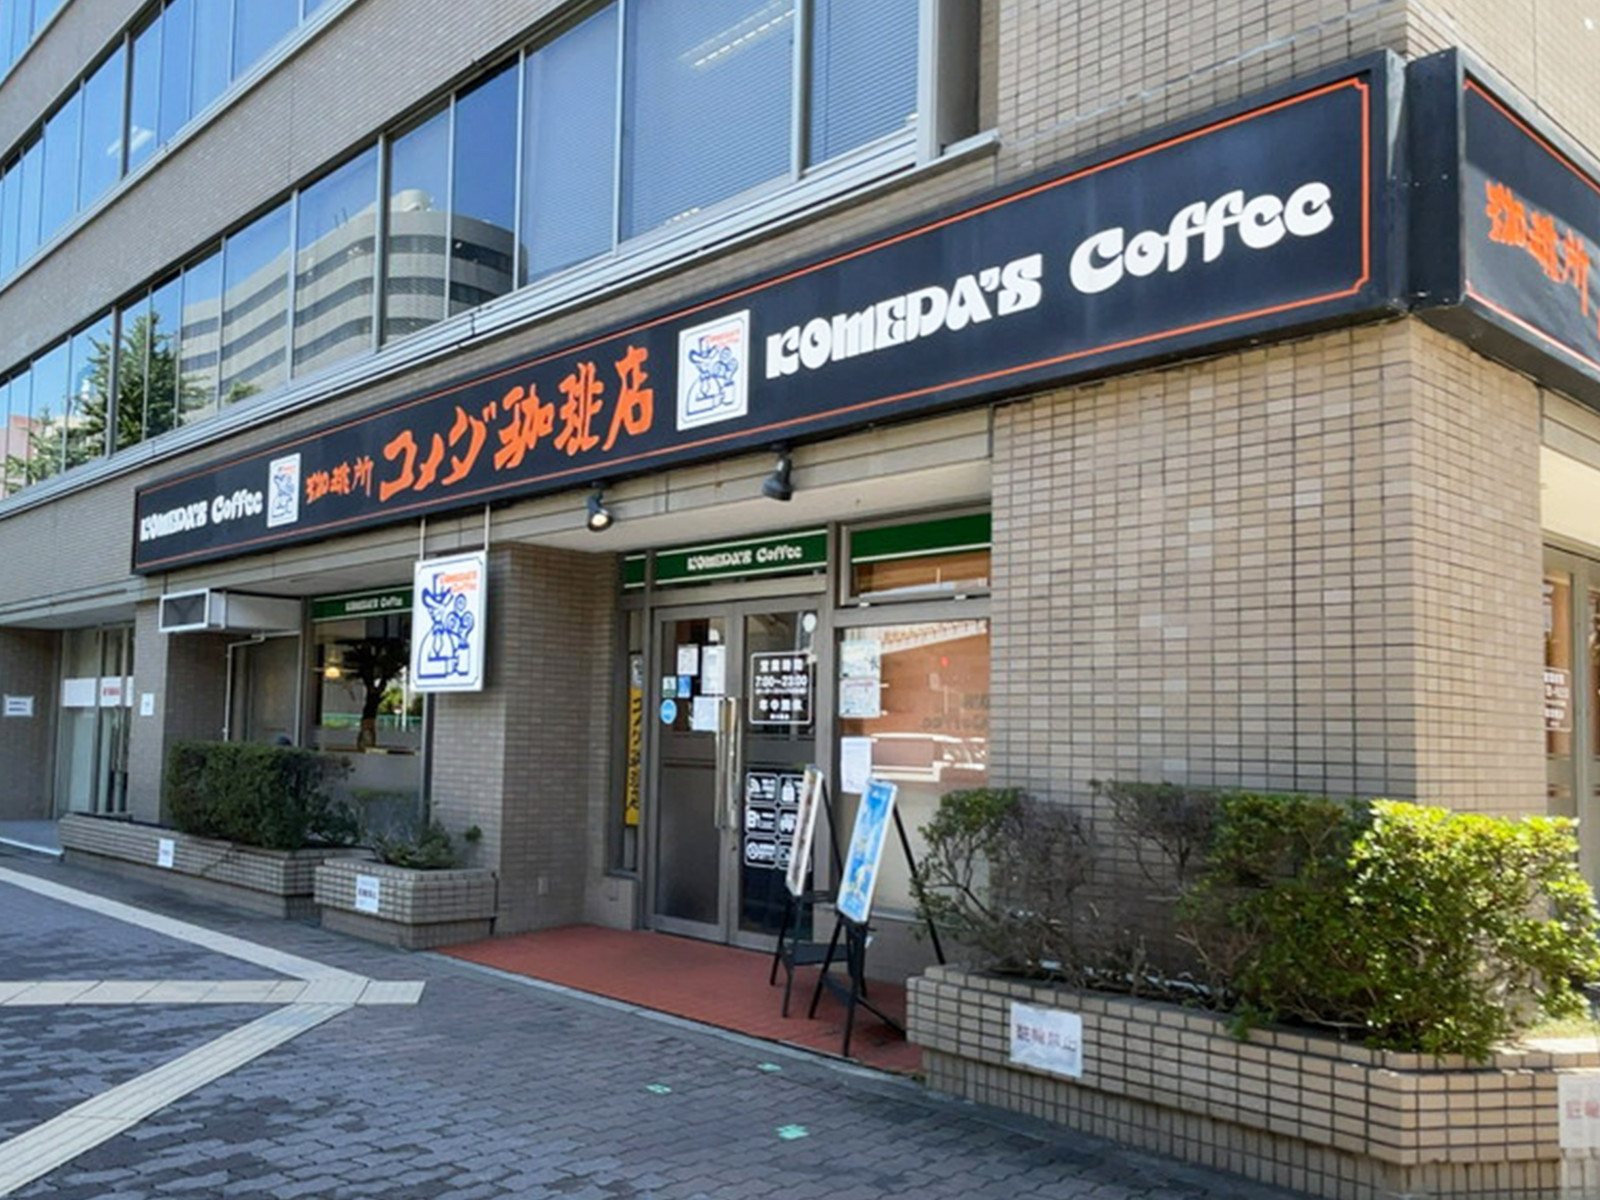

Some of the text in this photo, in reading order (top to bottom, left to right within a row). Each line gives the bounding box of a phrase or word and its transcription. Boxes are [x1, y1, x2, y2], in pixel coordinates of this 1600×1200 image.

[1070, 182, 1334, 294] Coffee
[379, 346, 655, 502] コメダ珈琲店
[211, 489, 263, 524] Coffee
[756, 544, 803, 563] Coffee
